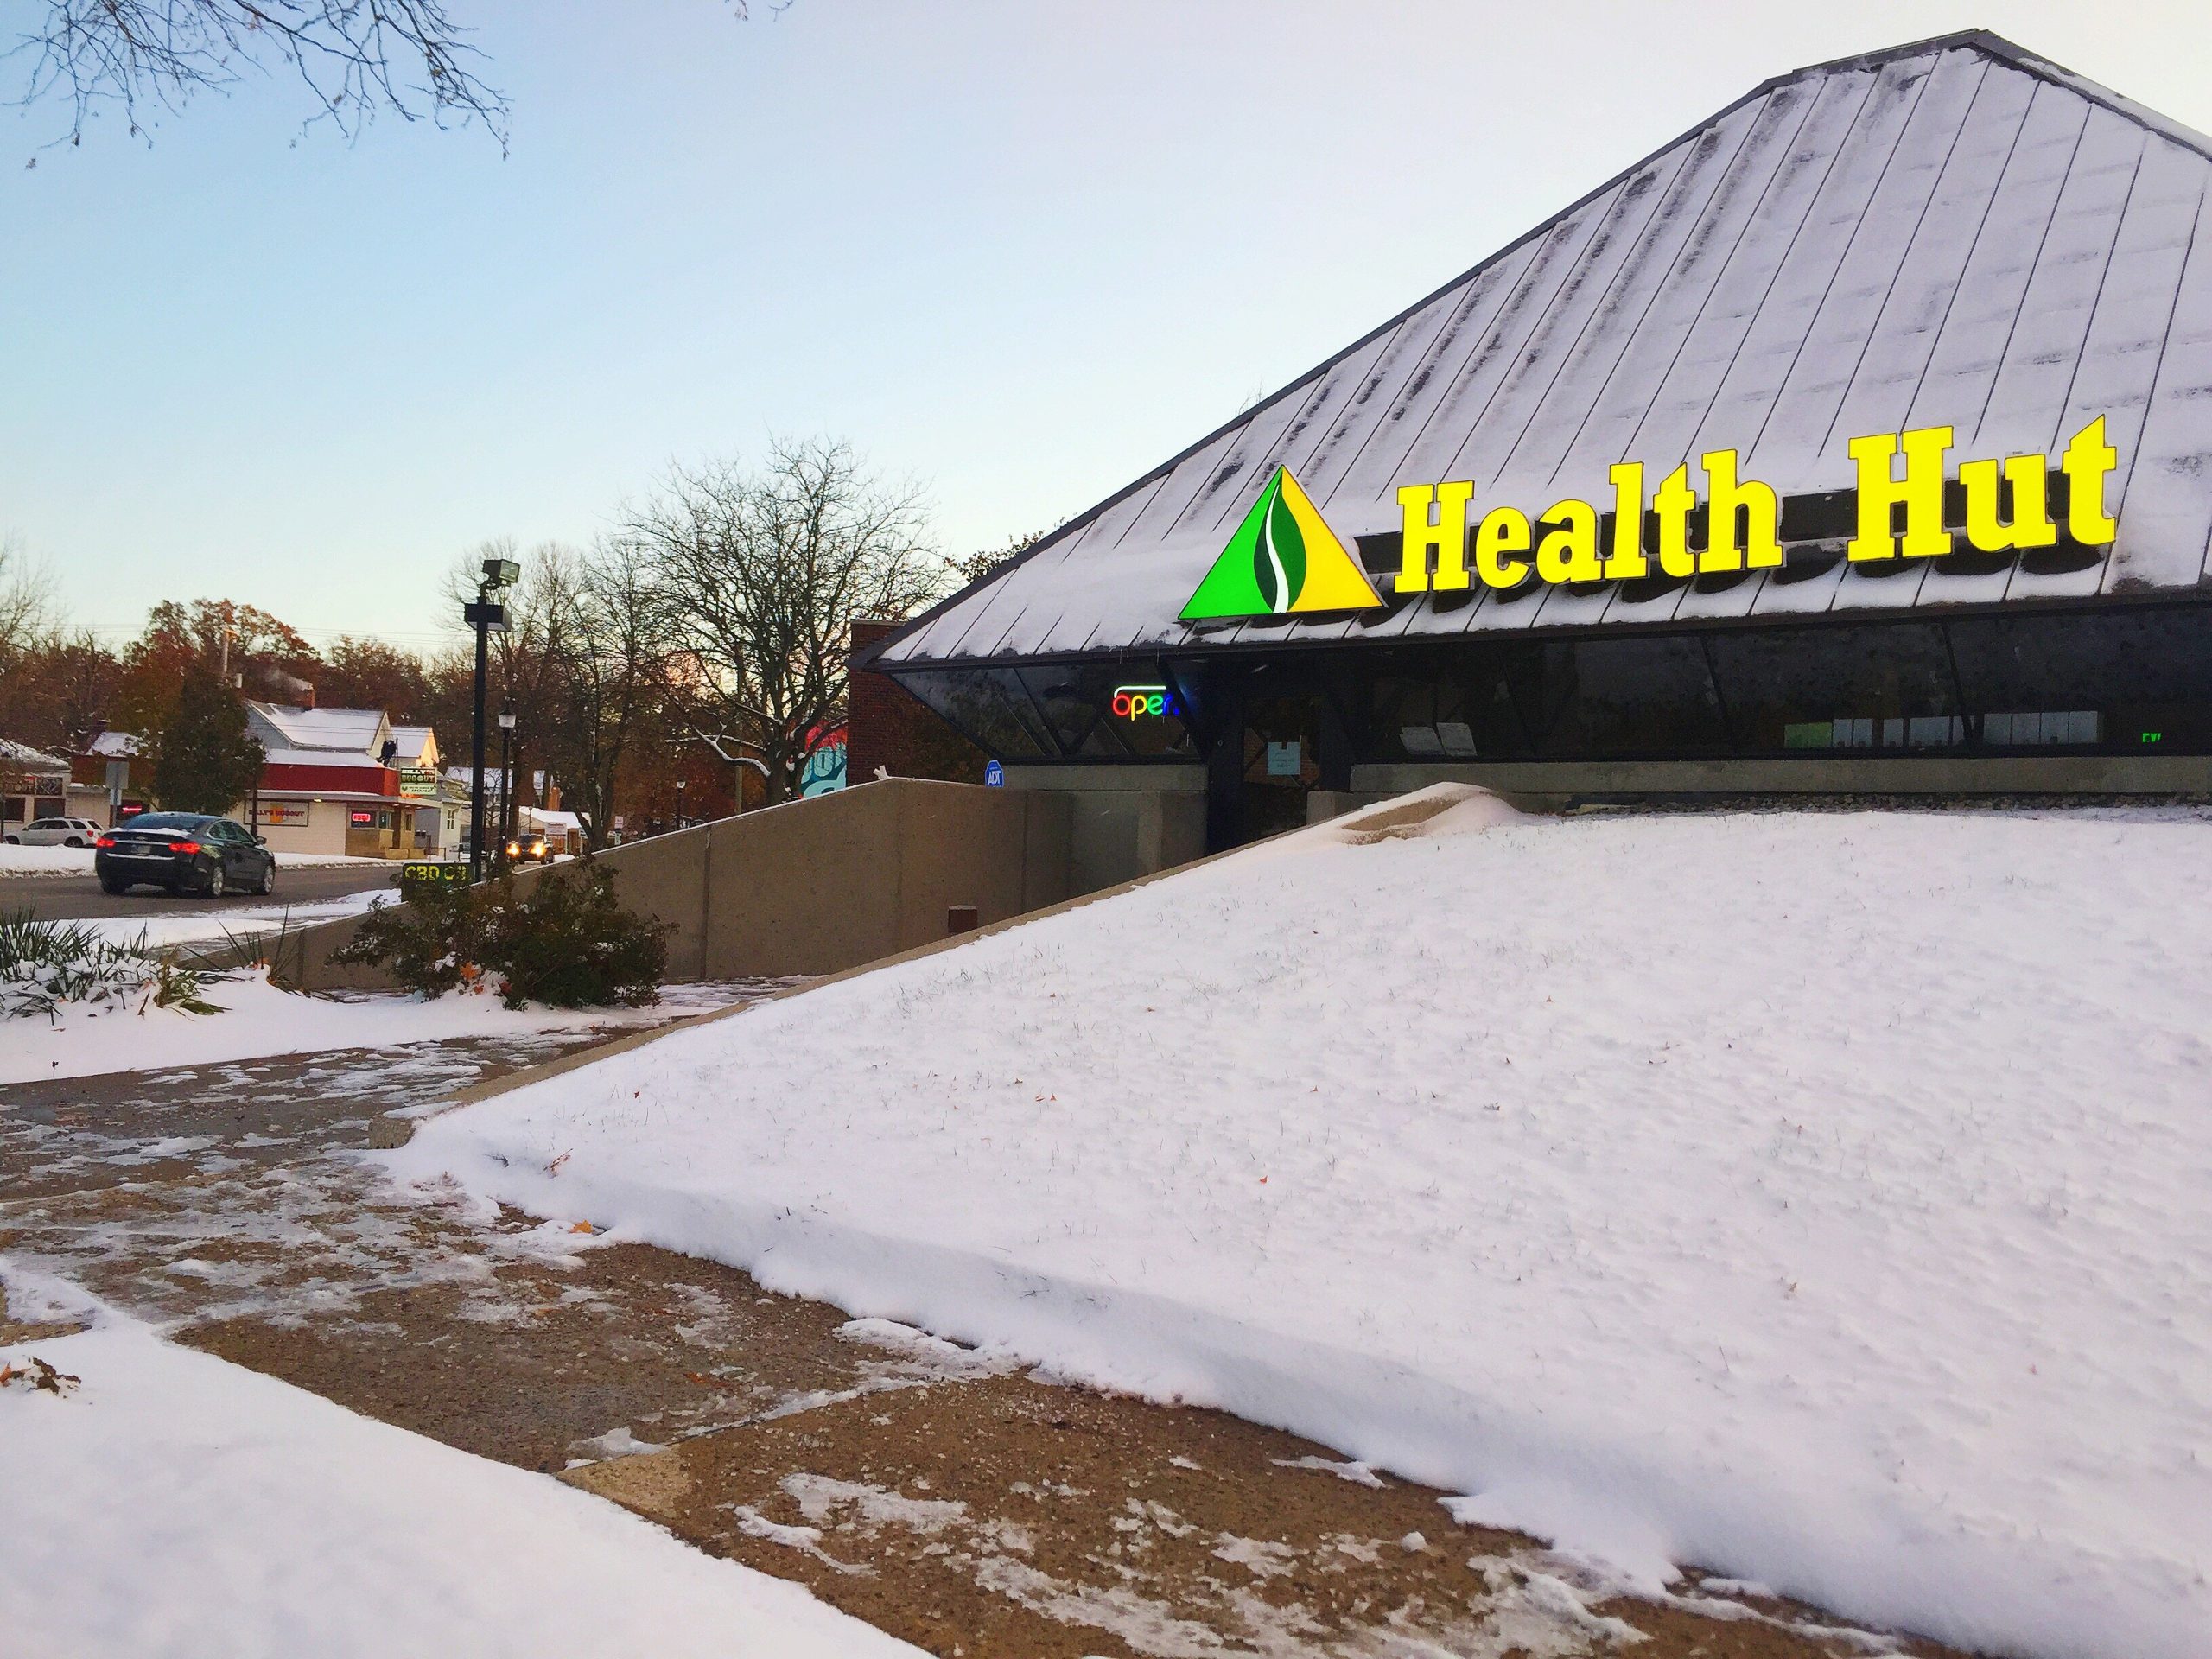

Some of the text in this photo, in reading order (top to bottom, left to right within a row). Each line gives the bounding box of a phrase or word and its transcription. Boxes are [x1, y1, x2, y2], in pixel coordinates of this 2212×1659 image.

[1394, 416, 2117, 593] Health Hut
[988, 770, 1001, 785] ADT
[404, 865, 441, 880] CBD
